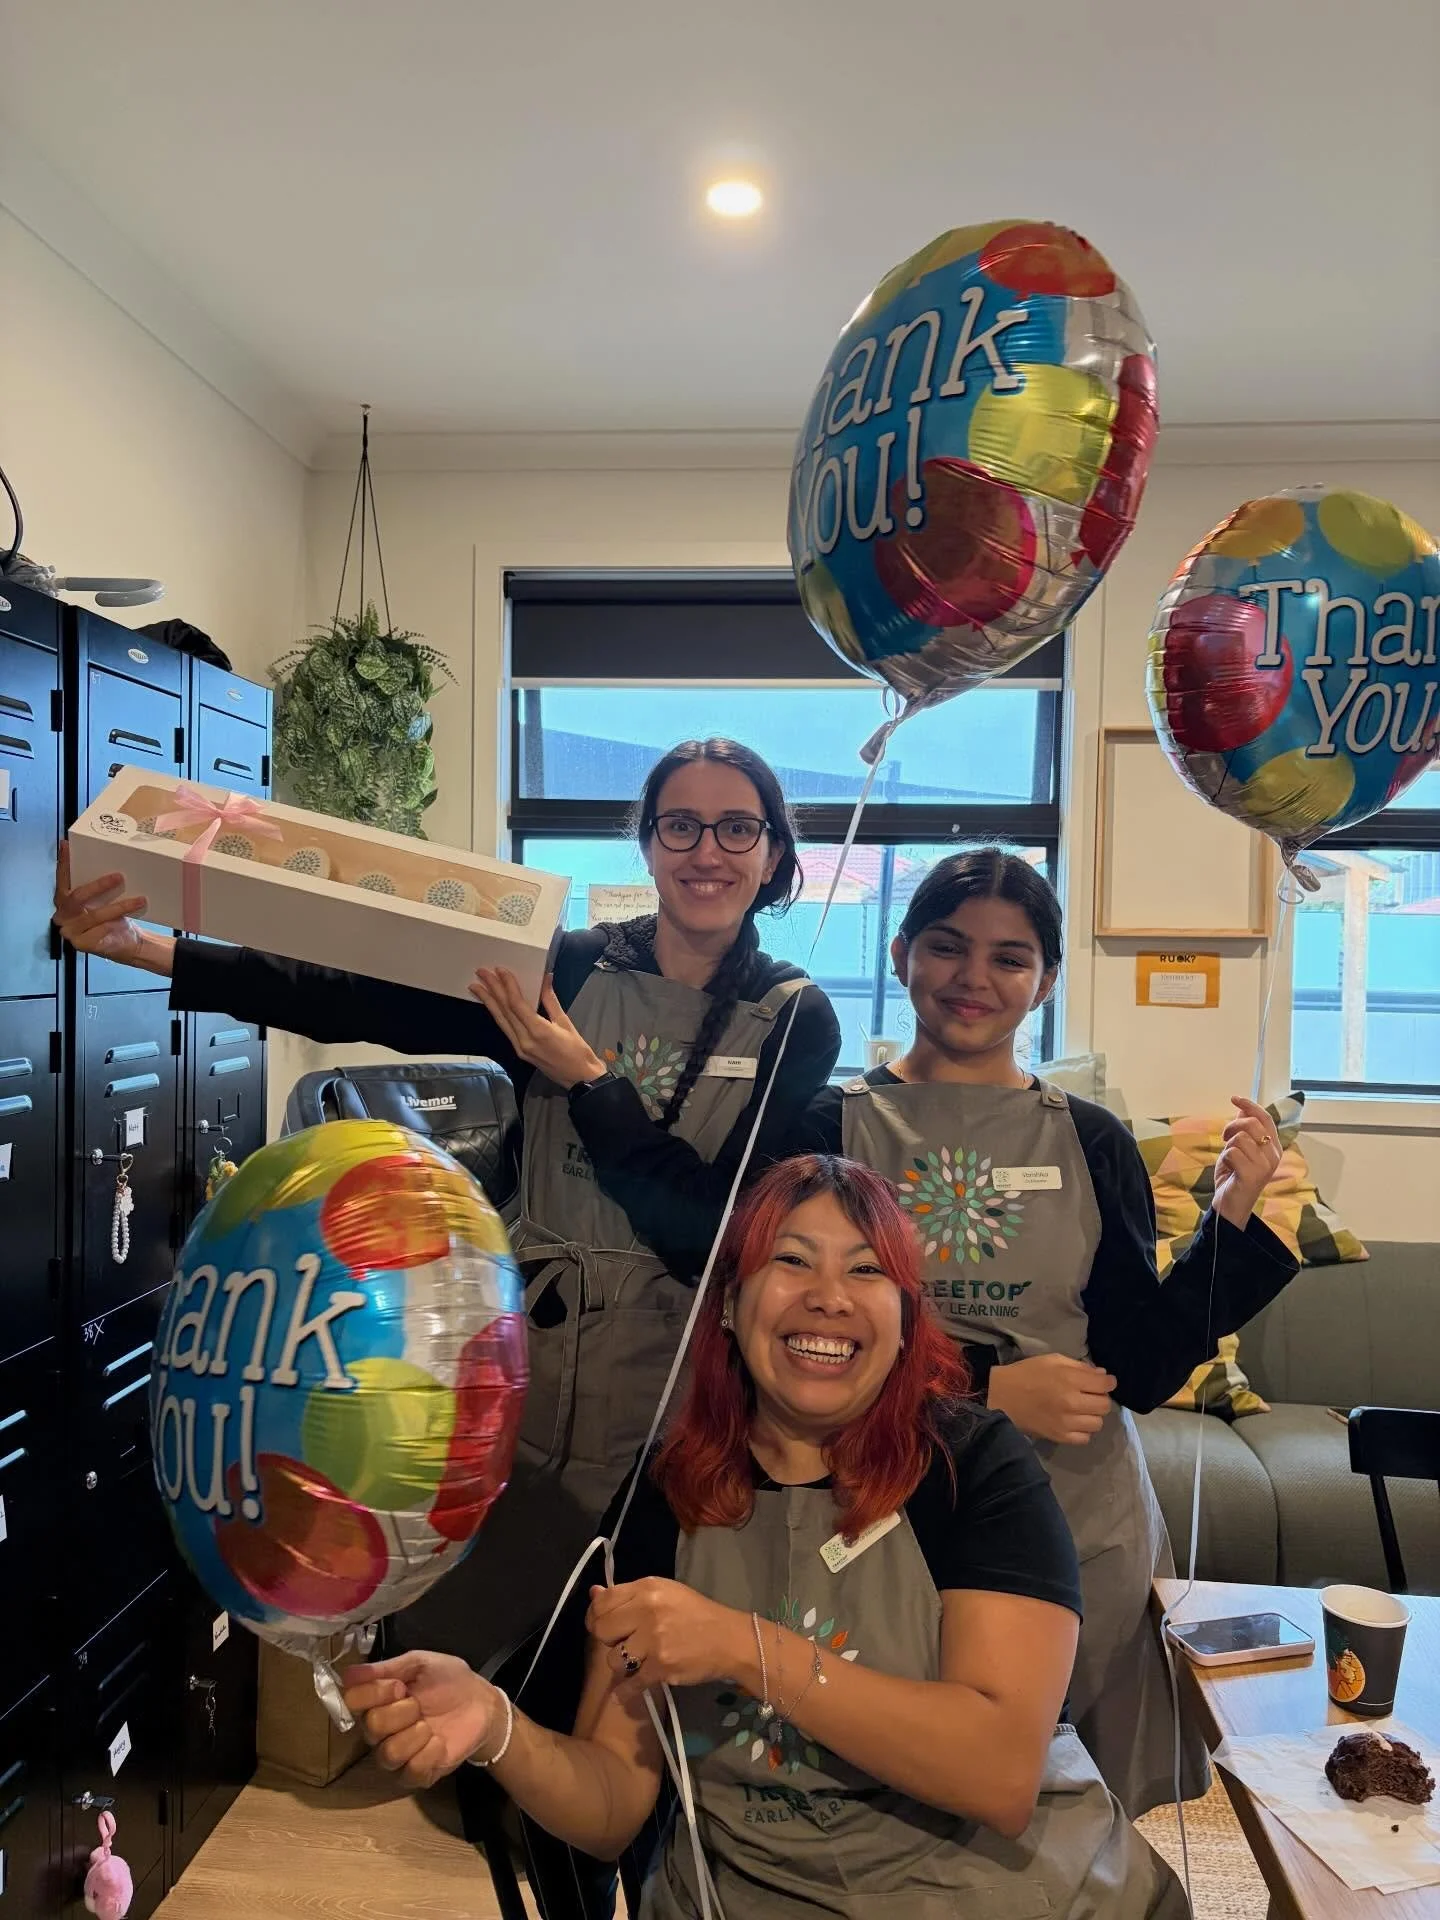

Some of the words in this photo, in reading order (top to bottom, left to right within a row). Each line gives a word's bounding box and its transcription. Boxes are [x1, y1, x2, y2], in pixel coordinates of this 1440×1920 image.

[805, 286, 1029, 455] hank
[795, 406, 922, 574] You!
[1239, 578, 1440, 667] Tha
[562, 1163, 592, 1181] EARL
[160, 1253, 368, 1389] ank
[920, 1279, 1030, 1301] EETOP
[950, 1303, 1020, 1318] LEARNING
